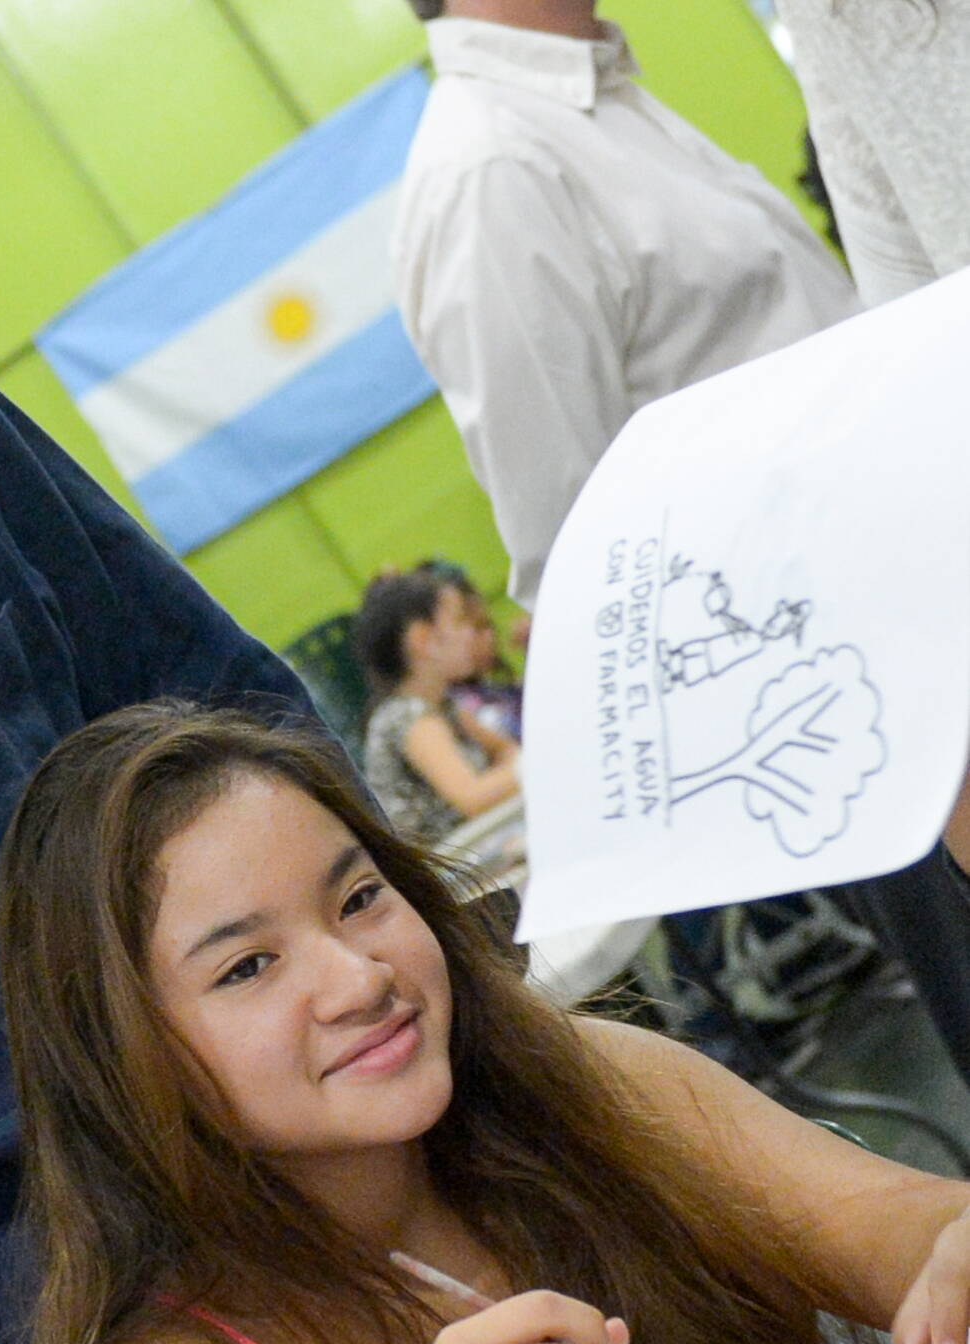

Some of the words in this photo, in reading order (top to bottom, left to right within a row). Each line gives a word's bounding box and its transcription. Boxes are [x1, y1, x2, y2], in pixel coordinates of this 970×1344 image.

[606, 538, 628, 586] CON
[626, 537, 659, 669] CUIDEMOS
[597, 650, 627, 820] FARMACITY
[627, 684, 650, 721] EL
[632, 740, 661, 815] AGUA
